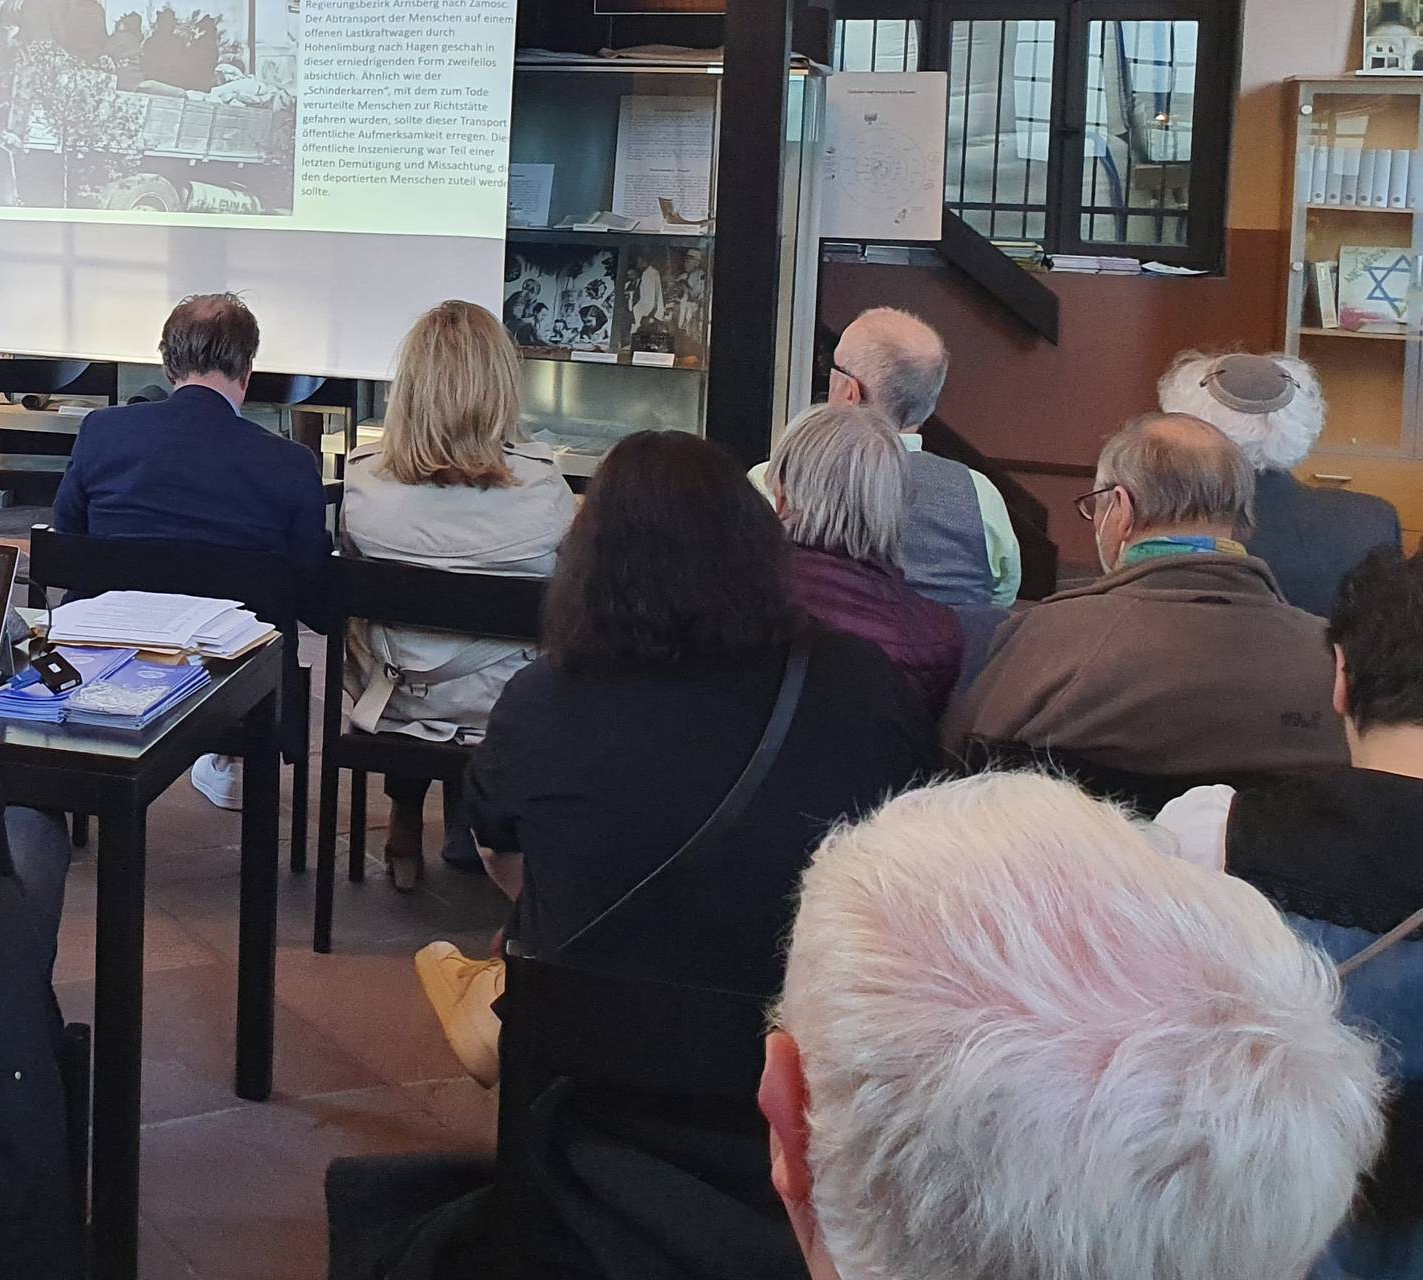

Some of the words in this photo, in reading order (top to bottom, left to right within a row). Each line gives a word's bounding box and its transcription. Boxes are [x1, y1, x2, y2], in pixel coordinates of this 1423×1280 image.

[305, 0, 389, 10] Regierungsbezirk
[393, 0, 439, 10] Arnsberg
[442, 0, 466, 8] nach
[305, 14, 322, 23] Der
[325, 14, 385, 24] Abtransport
[388, 14, 405, 22] der
[409, 13, 462, 22] Menschen
[465, 13, 481, 22] auf
[483, 14, 514, 24] einem
[305, 29, 342, 37] offenen
[346, 28, 422, 38] Lastkraftwagen
[426, 28, 455, 37] durch
[305, 43, 375, 53] Hohenlimburg
[378, 42, 402, 51] nach
[406, 42, 438, 53] Hagen
[442, 43, 482, 53] geschah
[485, 43, 495, 52] in
[304, 57, 333, 66] dieser
[337, 57, 414, 68] erniedrigenden
[418, 57, 445, 66] Form
[447, 57, 496, 67] zweifellos
[304, 71, 358, 80] absichtlich.
[361, 71, 400, 80] Ähnlich
[403, 72, 421, 80] wie
[424, 72, 441, 80] der
[394, 86, 411, 95] mit
[414, 86, 437, 95] dem
[465, 86, 489, 96] Tode
[303, 100, 354, 110] verurteilte
[357, 101, 411, 110] Menschen
[414, 102, 429, 110] zur
[434, 101, 488, 111] Richtstätte
[303, 115, 346, 125] gefahren
[349, 116, 391, 125] wurden,
[394, 115, 423, 125] sollte
[426, 116, 457, 125] dieser
[460, 117, 506, 127] Transport
[302, 129, 355, 138] öffentliche
[357, 130, 442, 140] Aufmerksamkeit
[446, 133, 487, 142] erregen.
[491, 132, 508, 142] Die
[302, 143, 354, 153] öffentliche
[357, 145, 424, 156] Inszenierung
[426, 147, 446, 155] war
[449, 146, 466, 155] Teil
[469, 147, 494, 156] einer
[301, 157, 335, 167] letzten
[338, 158, 401, 171] Demütigung
[404, 161, 424, 169] und
[428, 161, 495, 173] Missachtung,
[301, 172, 320, 181] den
[323, 173, 386, 184] deportierten
[390, 174, 445, 184] Menschen
[448, 177, 475, 186] zuteil
[301, 187, 330, 196] sollte.
